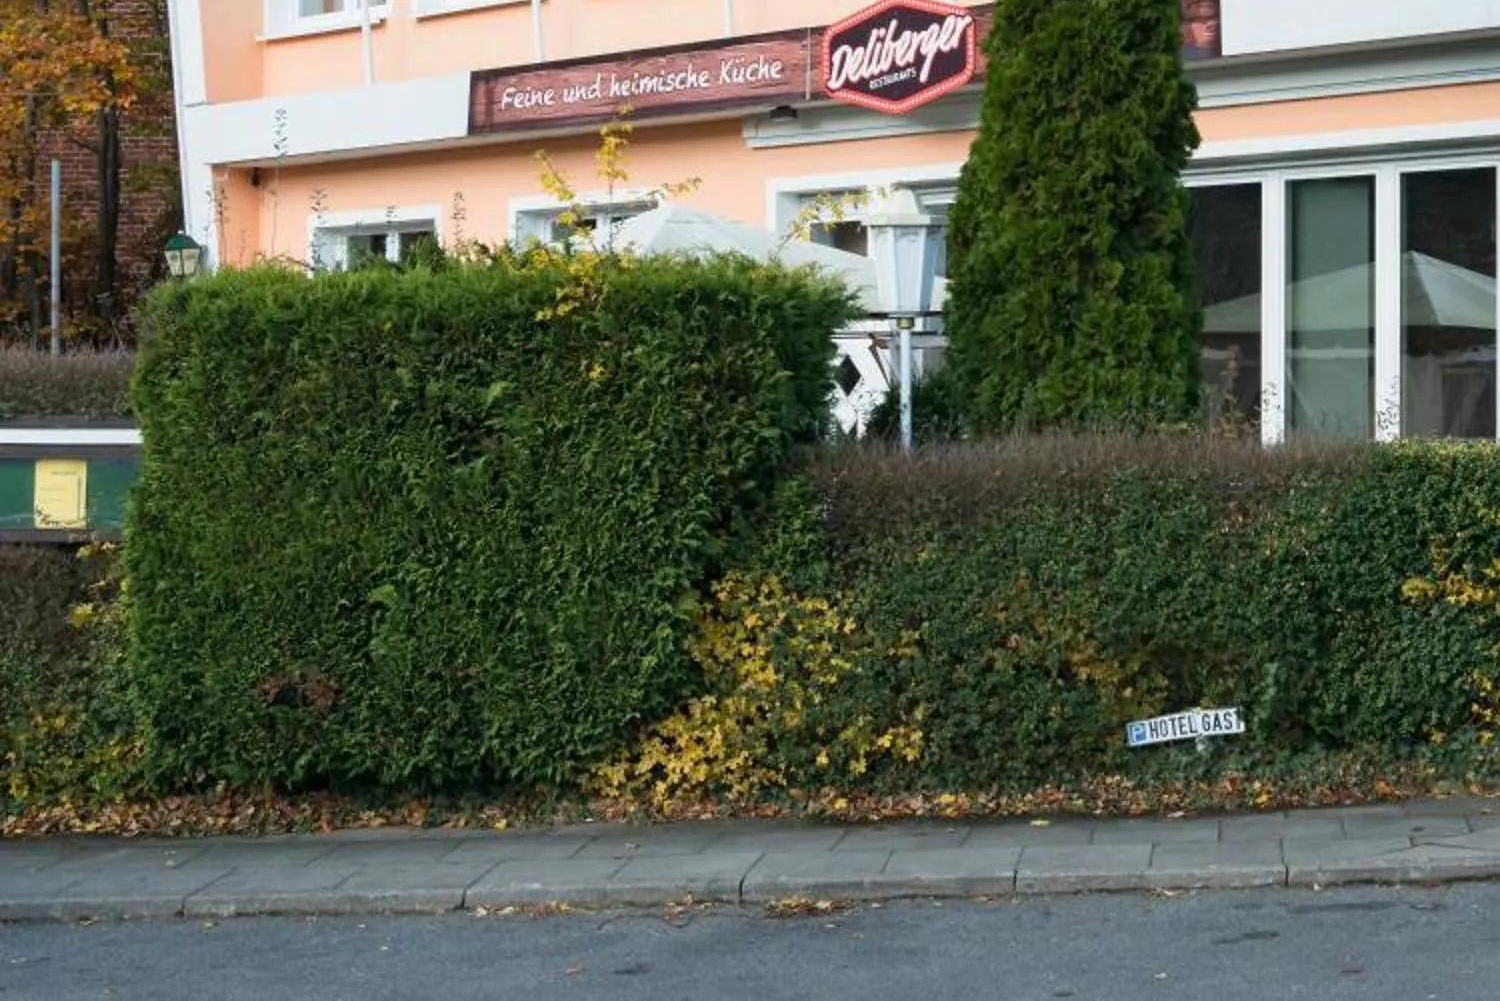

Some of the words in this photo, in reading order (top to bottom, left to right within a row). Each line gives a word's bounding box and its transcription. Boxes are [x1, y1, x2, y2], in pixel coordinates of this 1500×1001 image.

[827, 14, 973, 90] Deliberger
[501, 86, 555, 110] Feine
[563, 73, 602, 101] und
[609, 64, 711, 98] heimische
[719, 55, 785, 85] Küche
[1149, 715, 1197, 739] HOTEL
